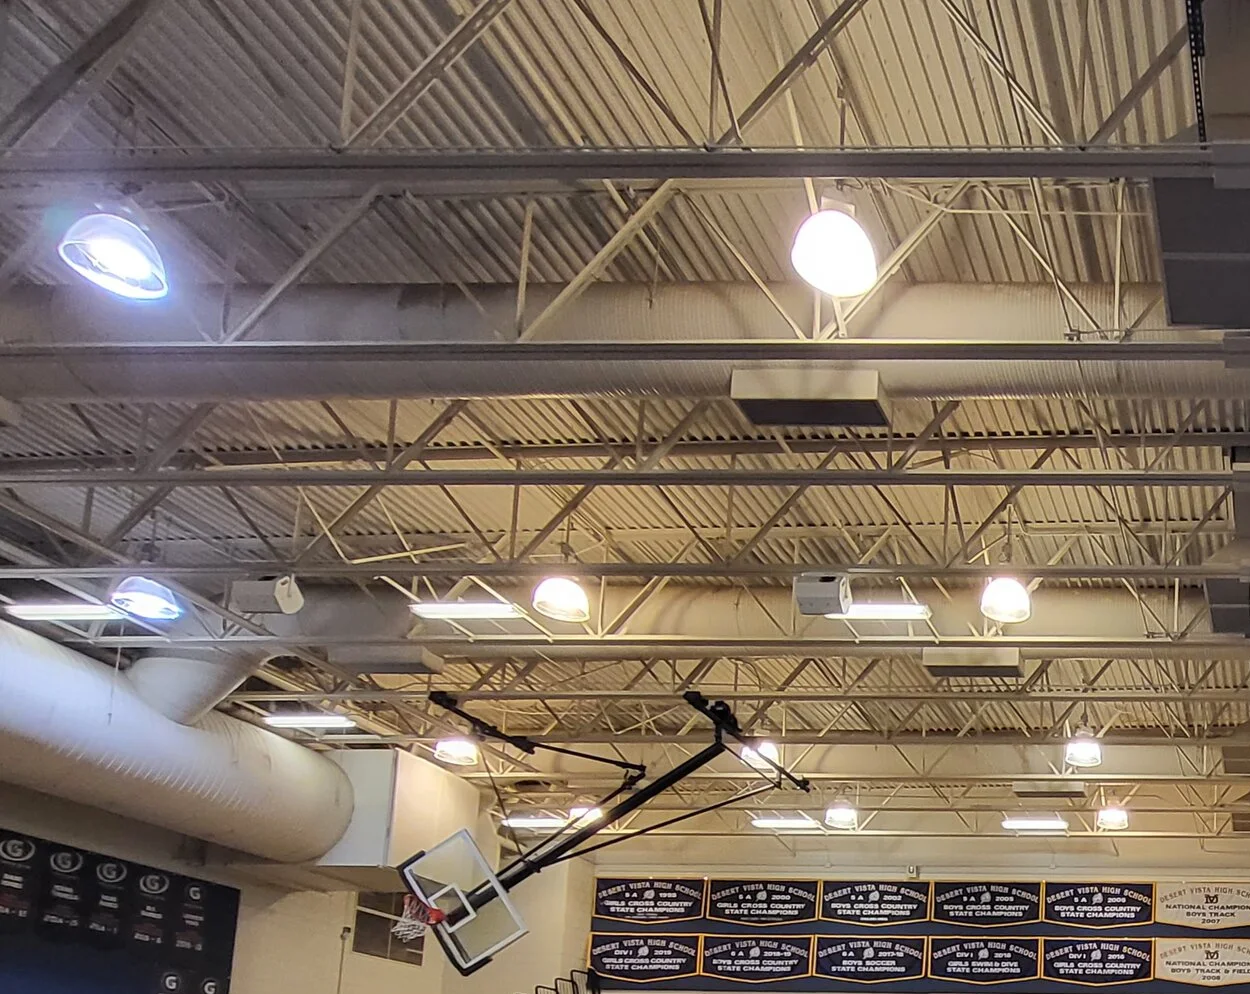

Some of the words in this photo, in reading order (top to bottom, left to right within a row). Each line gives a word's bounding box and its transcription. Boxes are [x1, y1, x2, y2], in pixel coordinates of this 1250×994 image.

[711, 887, 739, 900] DESERT
[788, 887, 815, 902] SCHOOL
[1160, 889, 1186, 903] DESERT
[1045, 946, 1073, 960] DESERT
[1076, 943, 1097, 951] VISTA
[1101, 943, 1120, 951] HIGH
[1122, 946, 1150, 961] SCHOOL
[1160, 946, 1186, 959] DESERT
